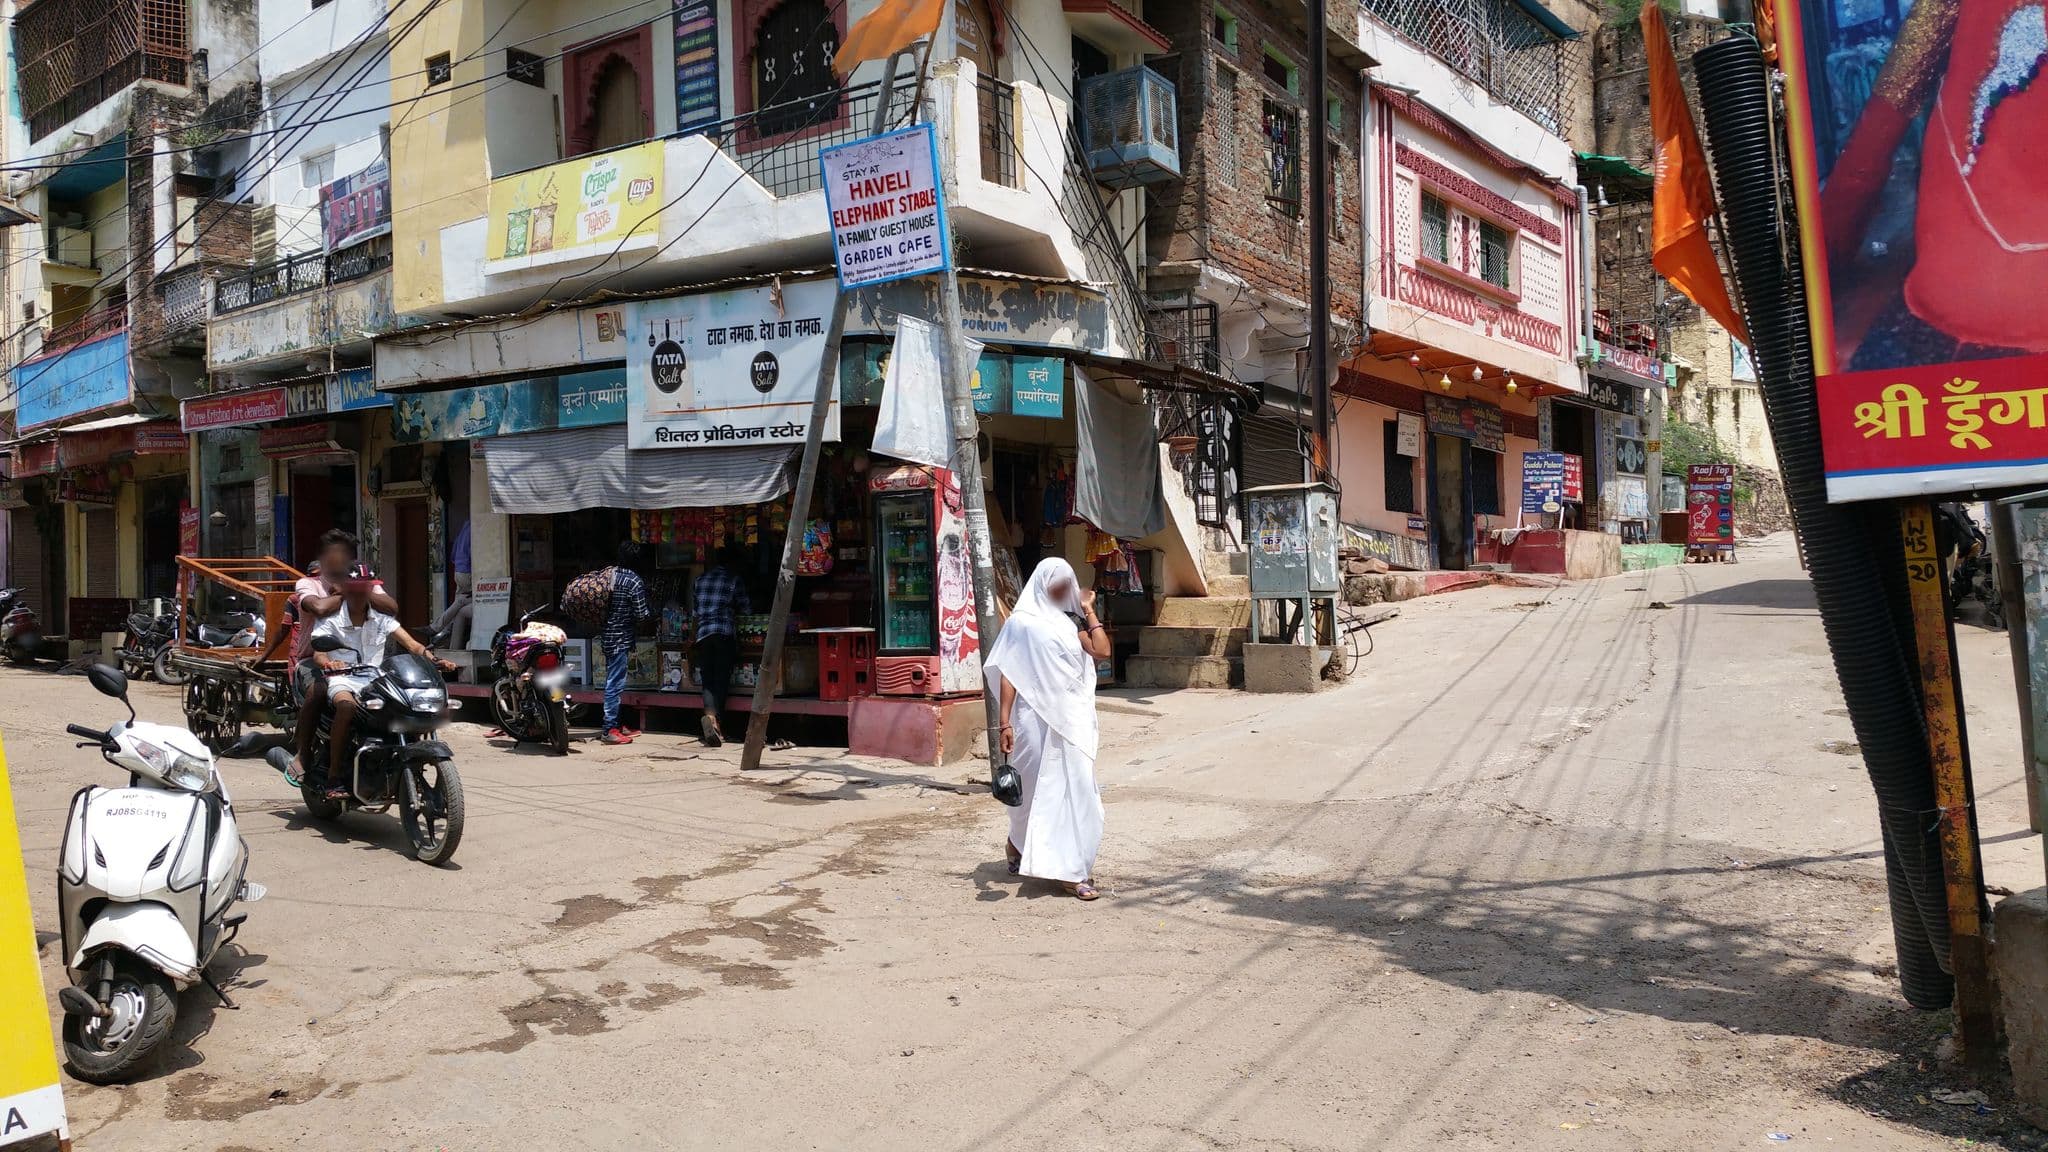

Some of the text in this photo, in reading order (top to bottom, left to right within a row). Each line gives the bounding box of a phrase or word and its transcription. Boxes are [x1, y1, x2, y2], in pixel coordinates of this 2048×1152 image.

[842, 164, 880, 181] STAY AT
[850, 170, 912, 201] HAVELI
[833, 188, 936, 229] ELEPHANT STABLE
[838, 213, 935, 247] A FAMILY GUEST HOUSE
[844, 244, 892, 266] GARDEN
[899, 235, 933, 255] CAFE
[707, 317, 824, 346] टाटा नमक. देश का नमक.
[656, 353, 683, 365] TATA
[754, 361, 777, 371] TATA
[658, 368, 681, 385] Salt
[756, 373, 775, 387] Salt
[1590, 382, 1618, 406] Cafe
[207, 408, 230, 422] Krishna
[244, 401, 277, 418] Jewellers
[1854, 383, 1928, 439] श्री
[656, 421, 806, 444] शितल प्रोविजन स्टोर
[1523, 460, 1543, 469] Guddu
[1692, 466, 1730, 476] Roof Top
[1908, 563, 1936, 582] 20
[498, 582, 509, 592] ART
